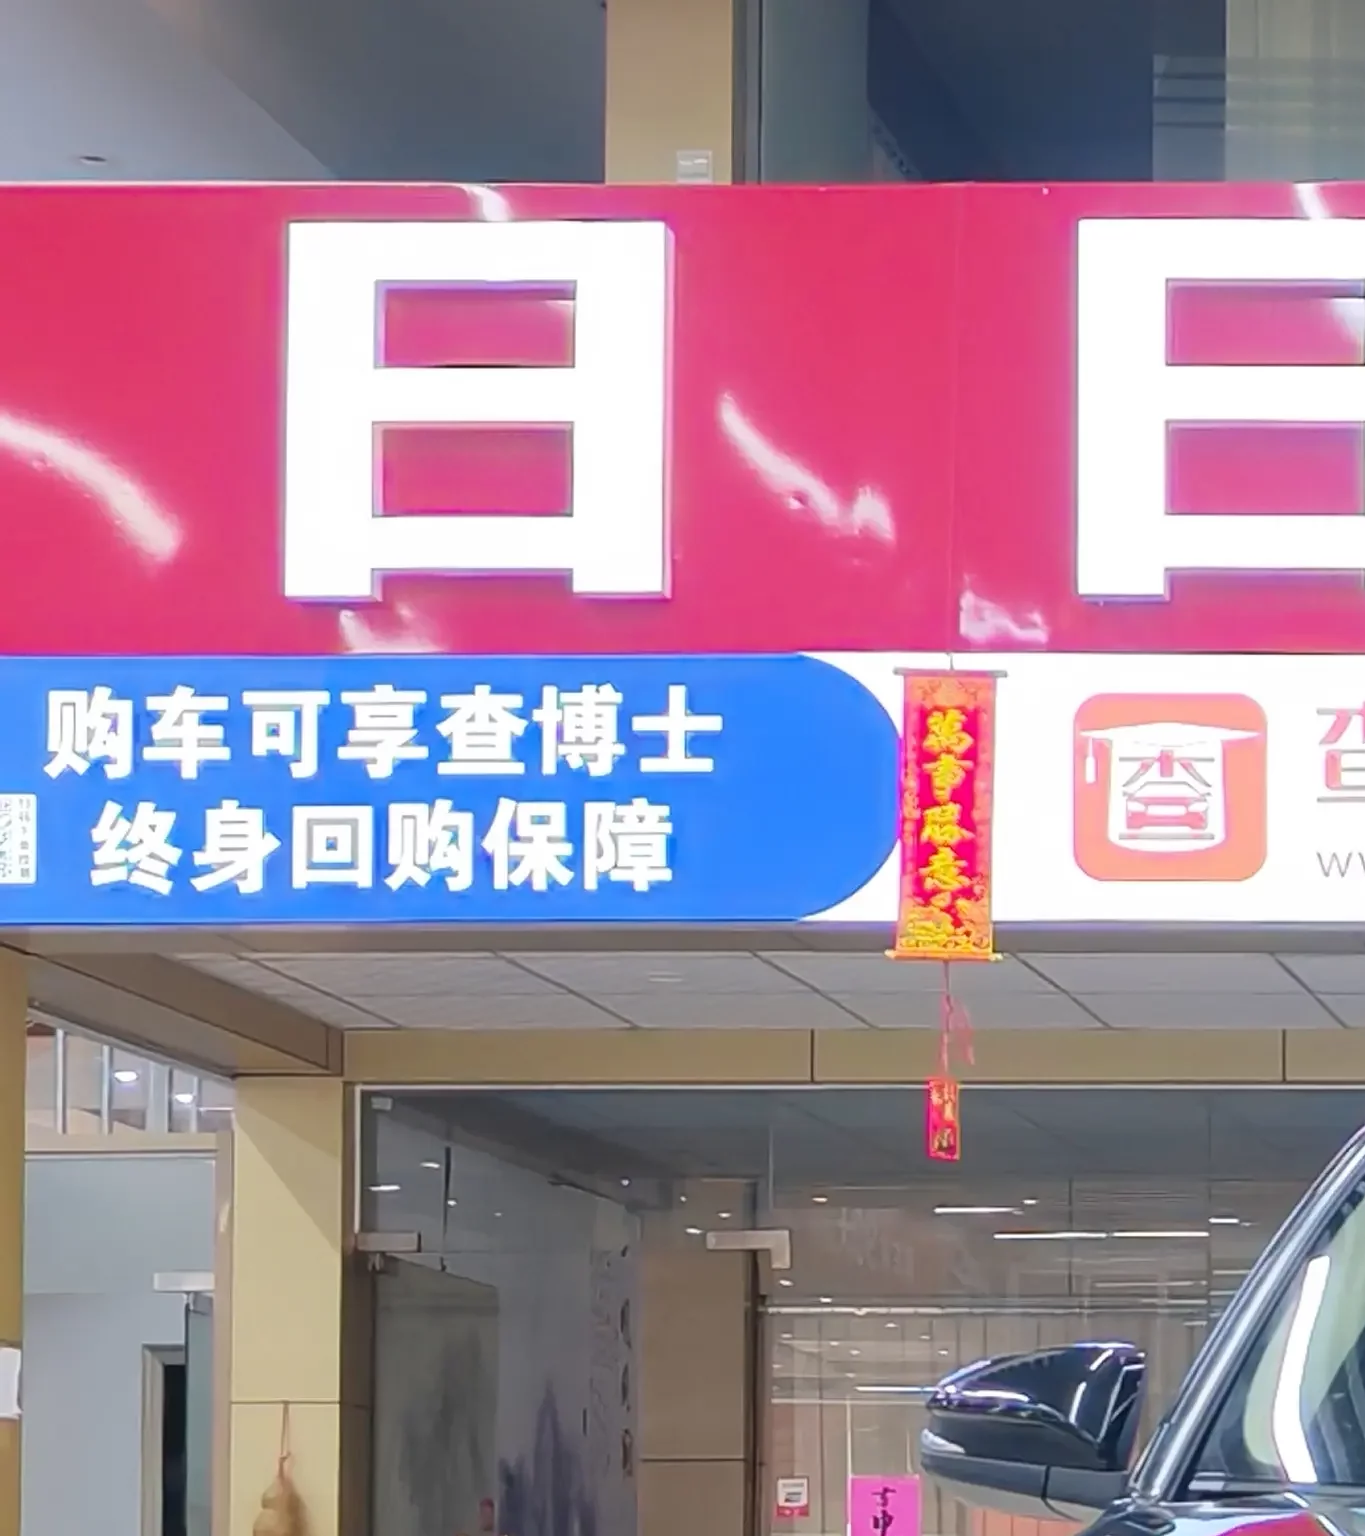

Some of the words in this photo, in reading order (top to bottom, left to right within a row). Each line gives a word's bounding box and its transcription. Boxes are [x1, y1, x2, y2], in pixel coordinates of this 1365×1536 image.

[44, 683, 723, 779] 购车可享查博士
[91, 797, 674, 894] 终身回购保障
